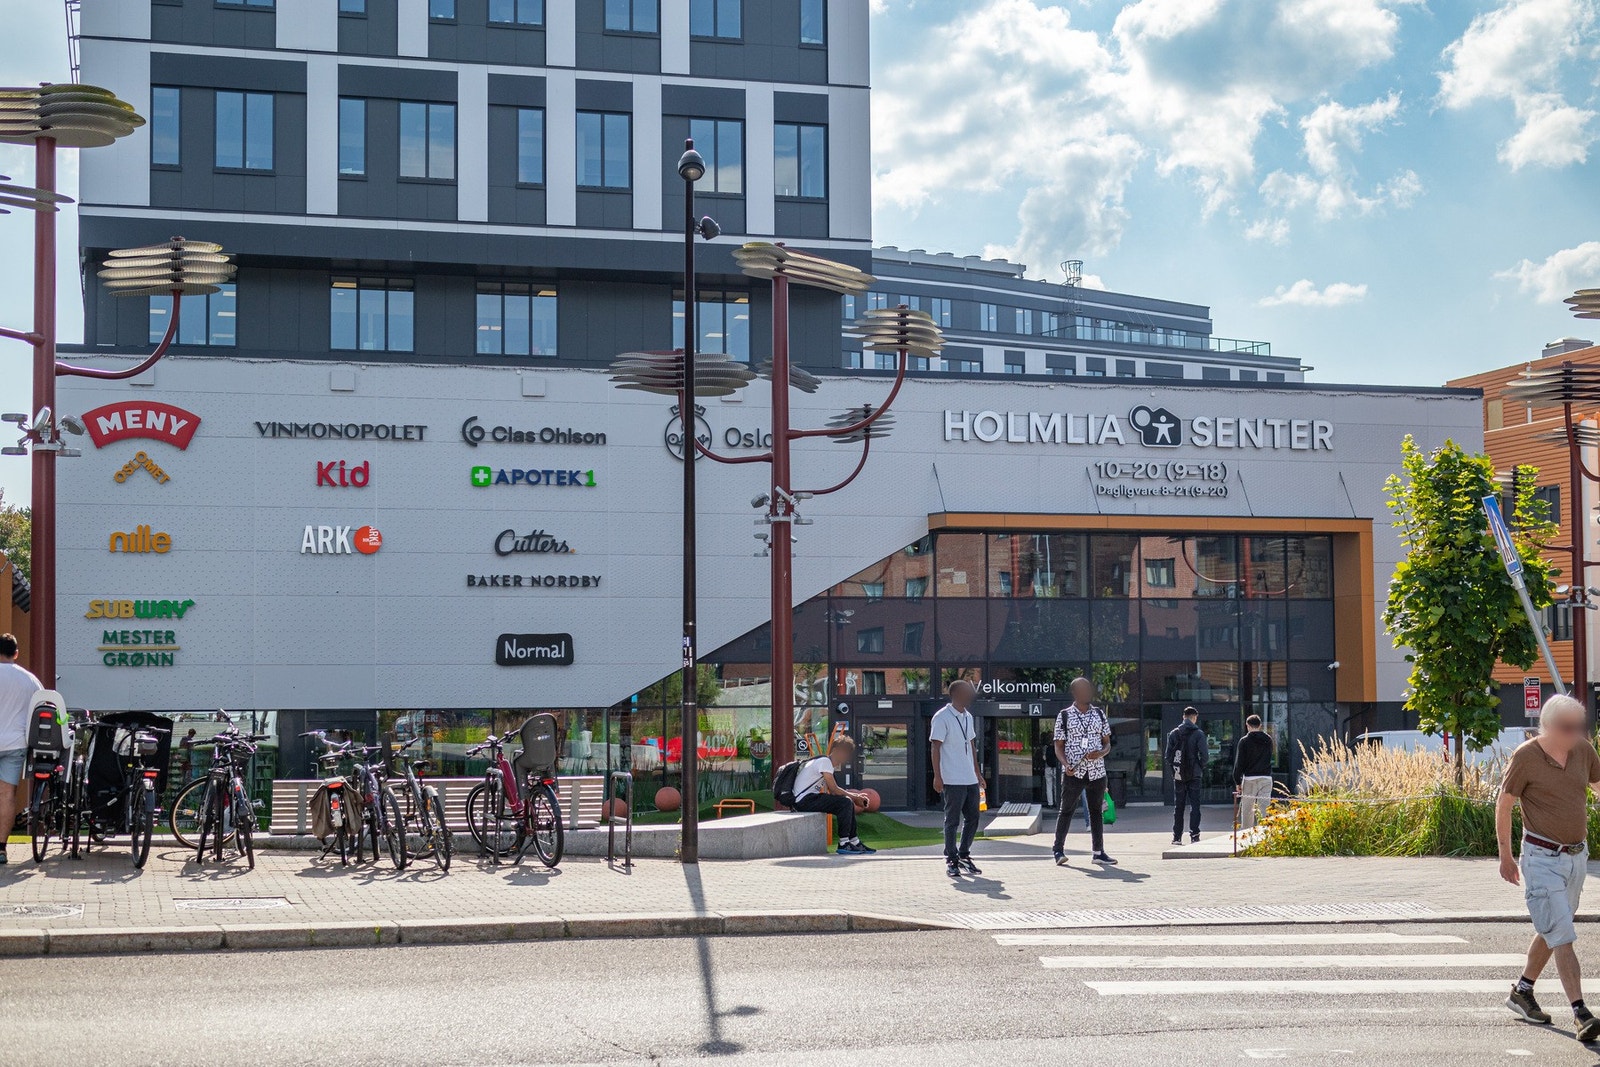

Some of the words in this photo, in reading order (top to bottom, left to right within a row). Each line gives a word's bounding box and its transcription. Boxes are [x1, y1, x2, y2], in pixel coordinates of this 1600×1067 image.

[96, 409, 188, 436] MENY
[254, 421, 428, 441] VINMONOPOLET
[943, 409, 1126, 446] HOLMLIA
[1191, 416, 1334, 450] SENTER
[492, 425, 536, 443] Clas
[540, 427, 607, 445] Ohlson
[316, 460, 370, 487] Kid
[495, 469, 583, 486] APOTEK
[1096, 484, 1158, 498] Dagligvare
[109, 524, 171, 553] nille
[301, 525, 352, 554] ARK
[467, 574, 523, 587] BAKER
[531, 575, 602, 587] NORDBY
[85, 598, 195, 619] SUBWAY
[102, 629, 176, 645] MESTER
[504, 639, 566, 659] Normal
[102, 652, 174, 667] GRØNN
[970, 679, 1056, 694] Velkommen
